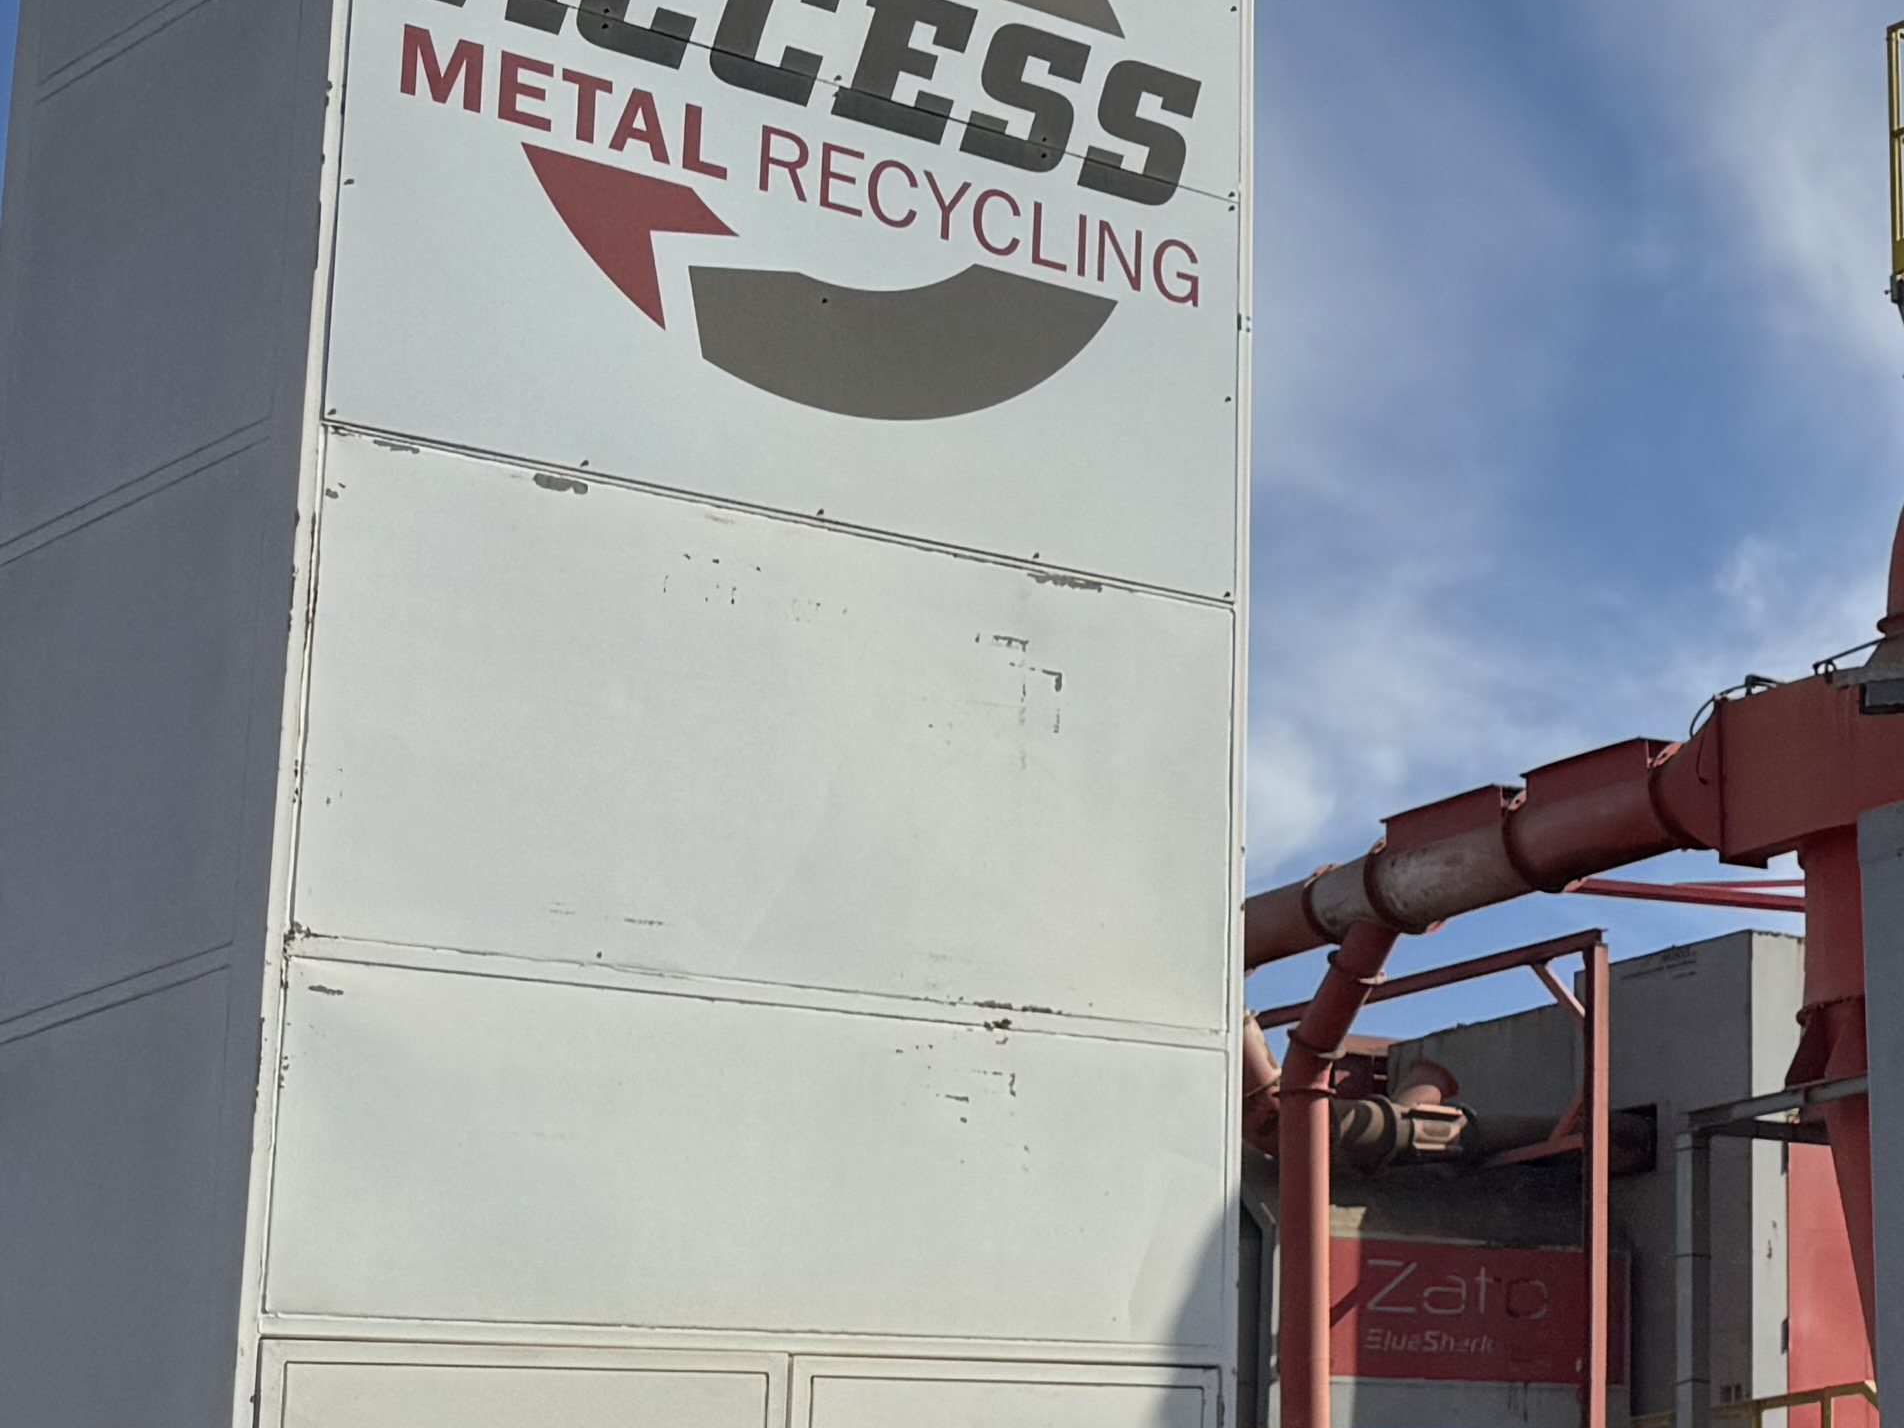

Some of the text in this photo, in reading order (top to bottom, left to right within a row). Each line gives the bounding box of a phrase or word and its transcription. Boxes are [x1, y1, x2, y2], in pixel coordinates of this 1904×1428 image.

[399, 23, 1200, 307] METAL RECYCLING
[1366, 1258, 1549, 1320] Zato
